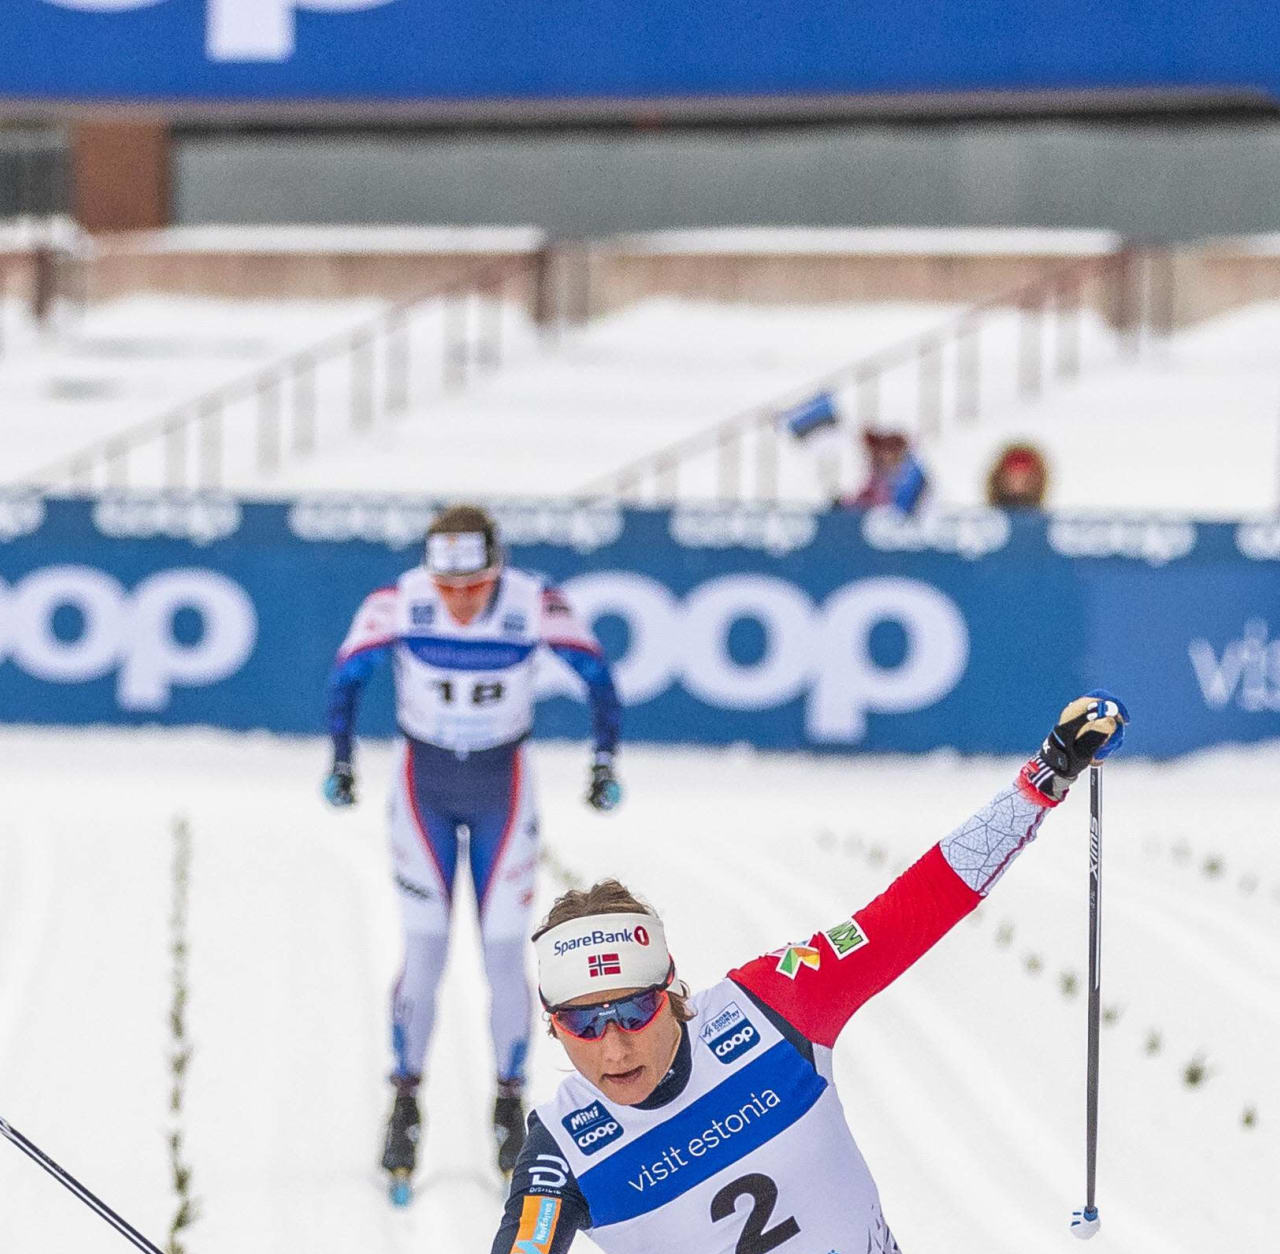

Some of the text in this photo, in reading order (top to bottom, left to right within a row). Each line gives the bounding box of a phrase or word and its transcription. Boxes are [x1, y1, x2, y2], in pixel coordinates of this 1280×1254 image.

[1089, 816, 1098, 880] SWIX
[553, 928, 634, 956] SpareBank
[714, 1026, 756, 1057] coop
[578, 1120, 620, 1149] coop
[628, 1087, 782, 1193] visit estonia
